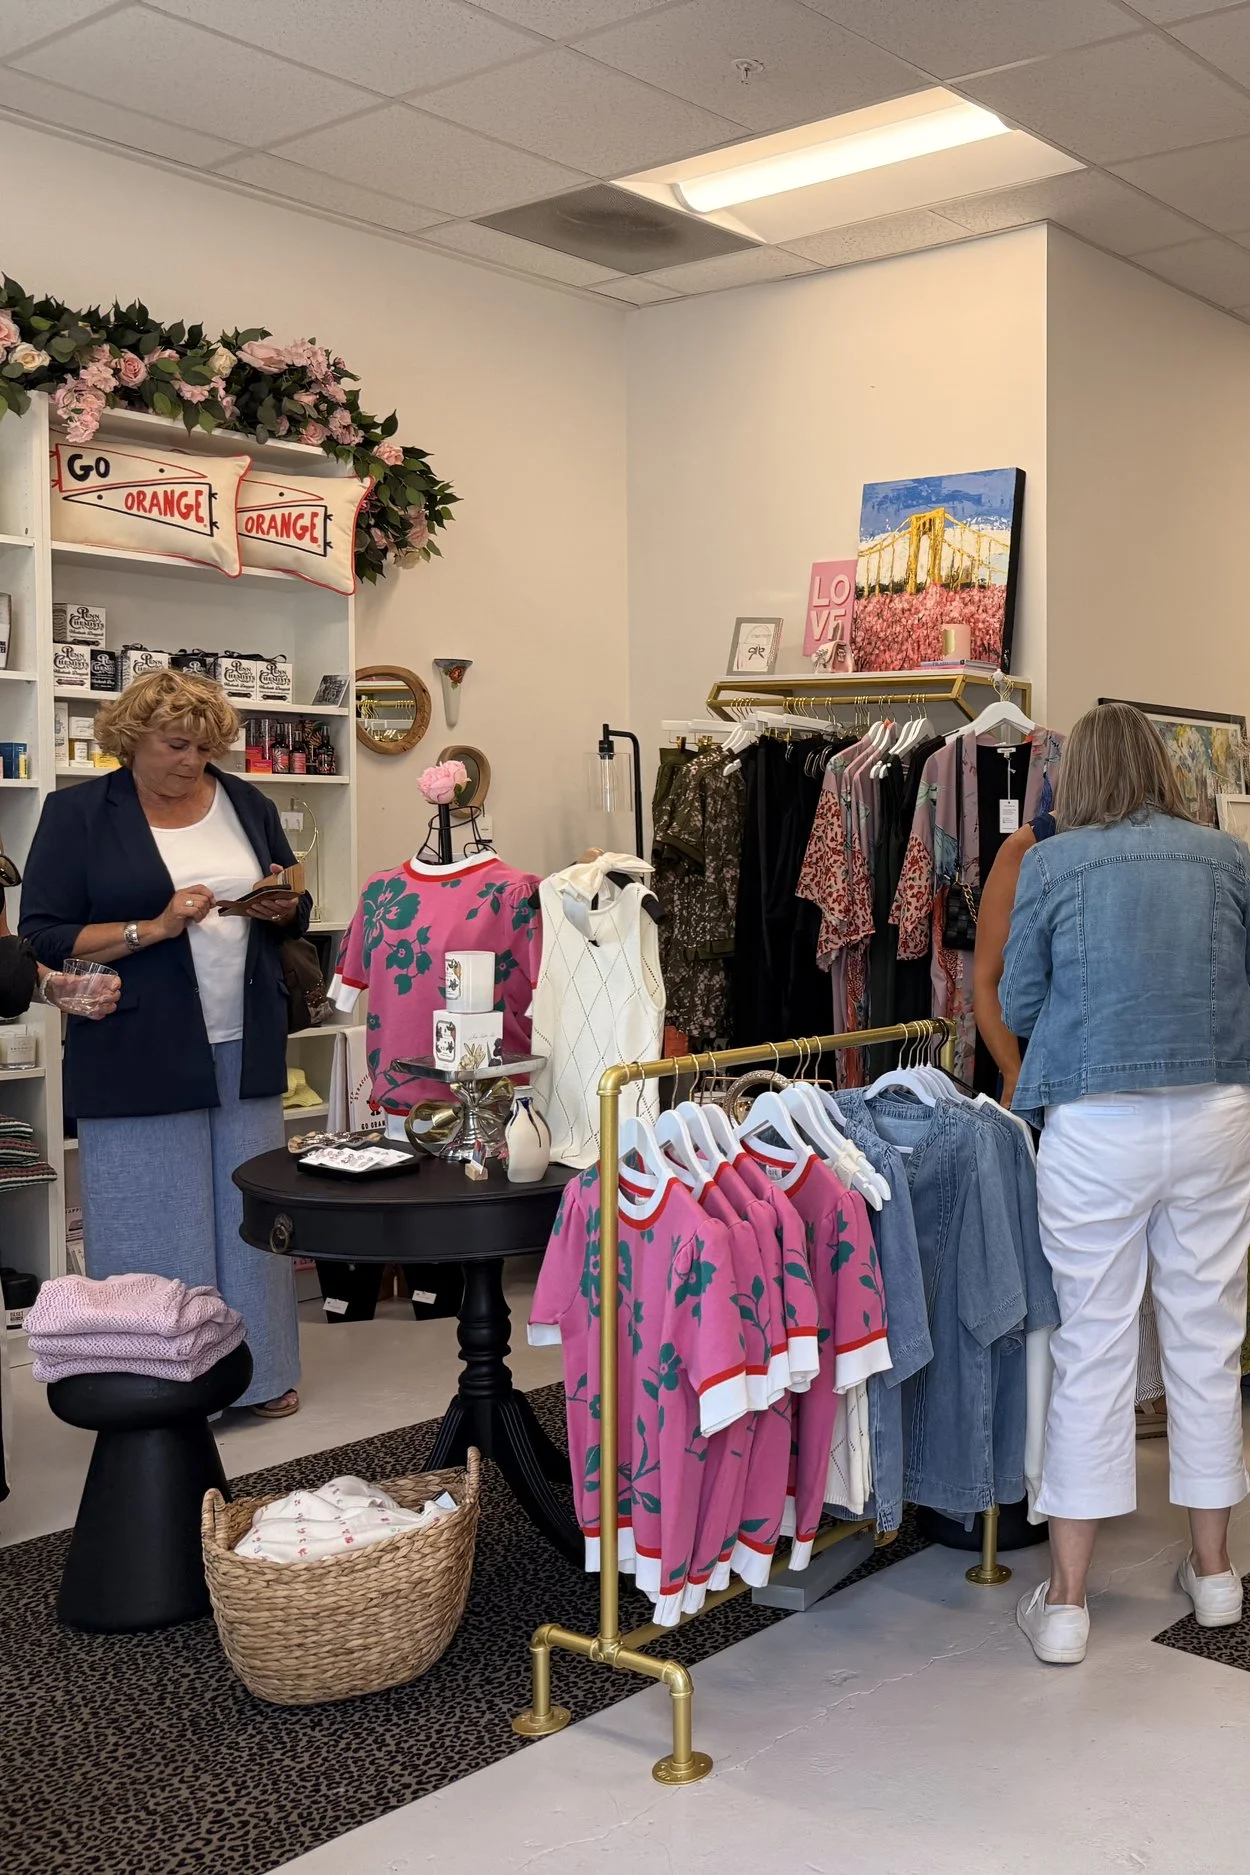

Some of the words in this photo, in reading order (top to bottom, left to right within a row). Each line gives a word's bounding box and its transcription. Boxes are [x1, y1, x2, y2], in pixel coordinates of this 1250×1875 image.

[67, 453, 110, 482] GO
[124, 489, 205, 524] ORANGE
[244, 511, 320, 544] ORANGE
[812, 574, 851, 607] LO
[371, 1120, 386, 1129] ORAN
